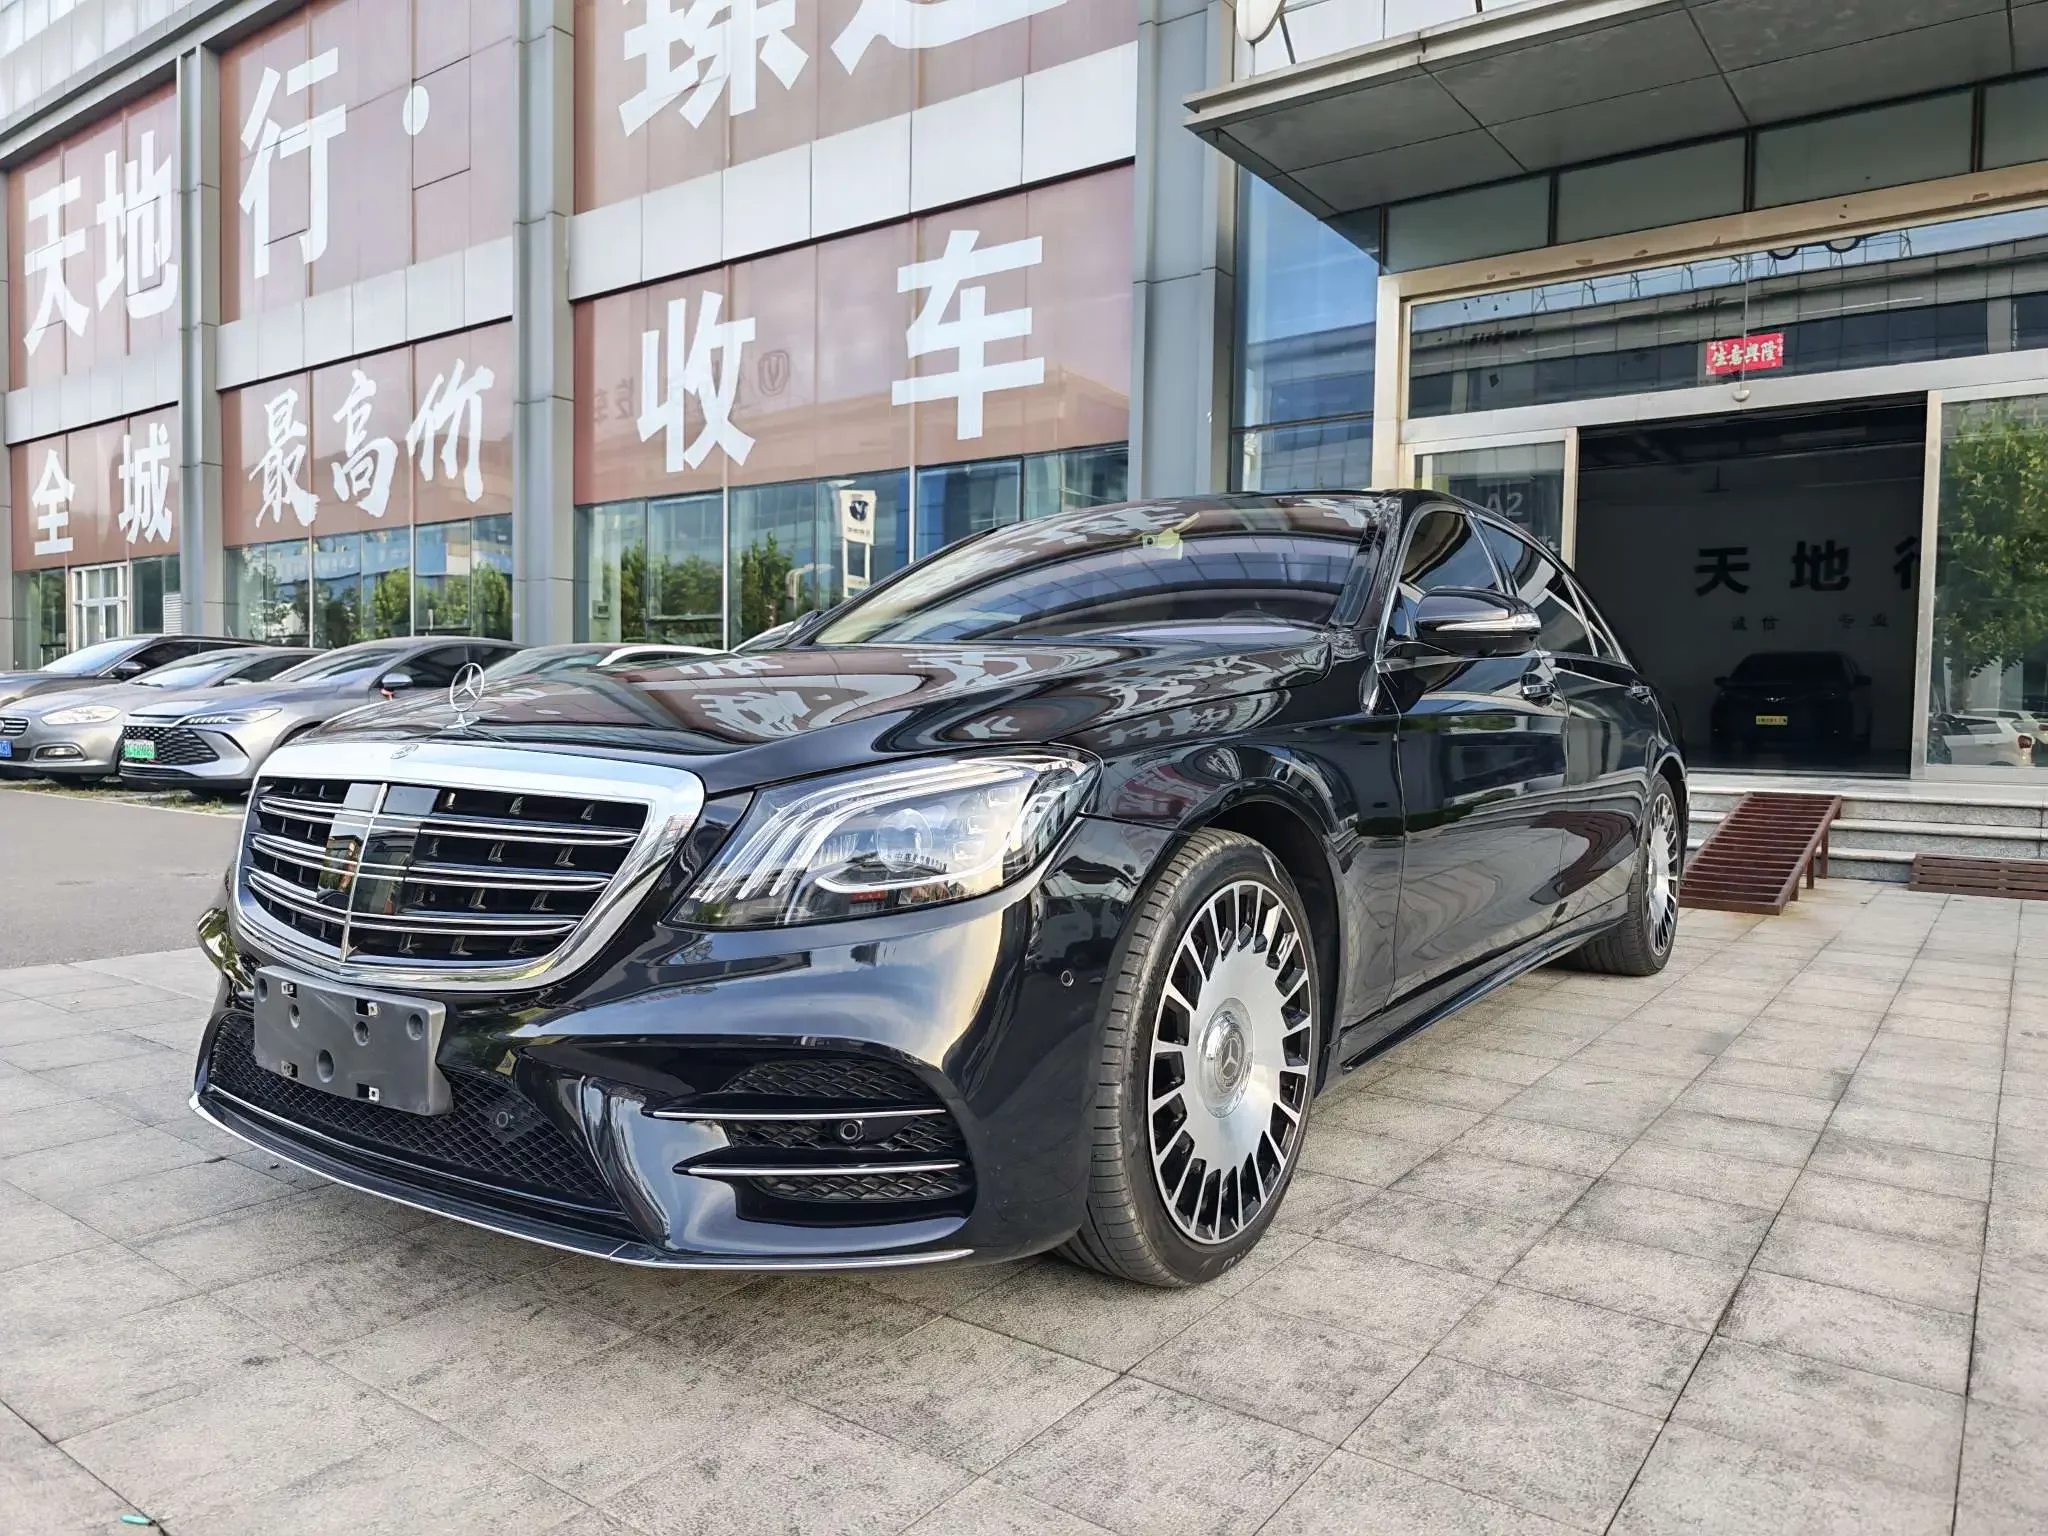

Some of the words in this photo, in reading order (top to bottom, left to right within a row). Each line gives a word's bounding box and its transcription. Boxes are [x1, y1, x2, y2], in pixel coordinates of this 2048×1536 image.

[32, 423, 173, 556] 全城
[249, 358, 495, 528] 最高价
